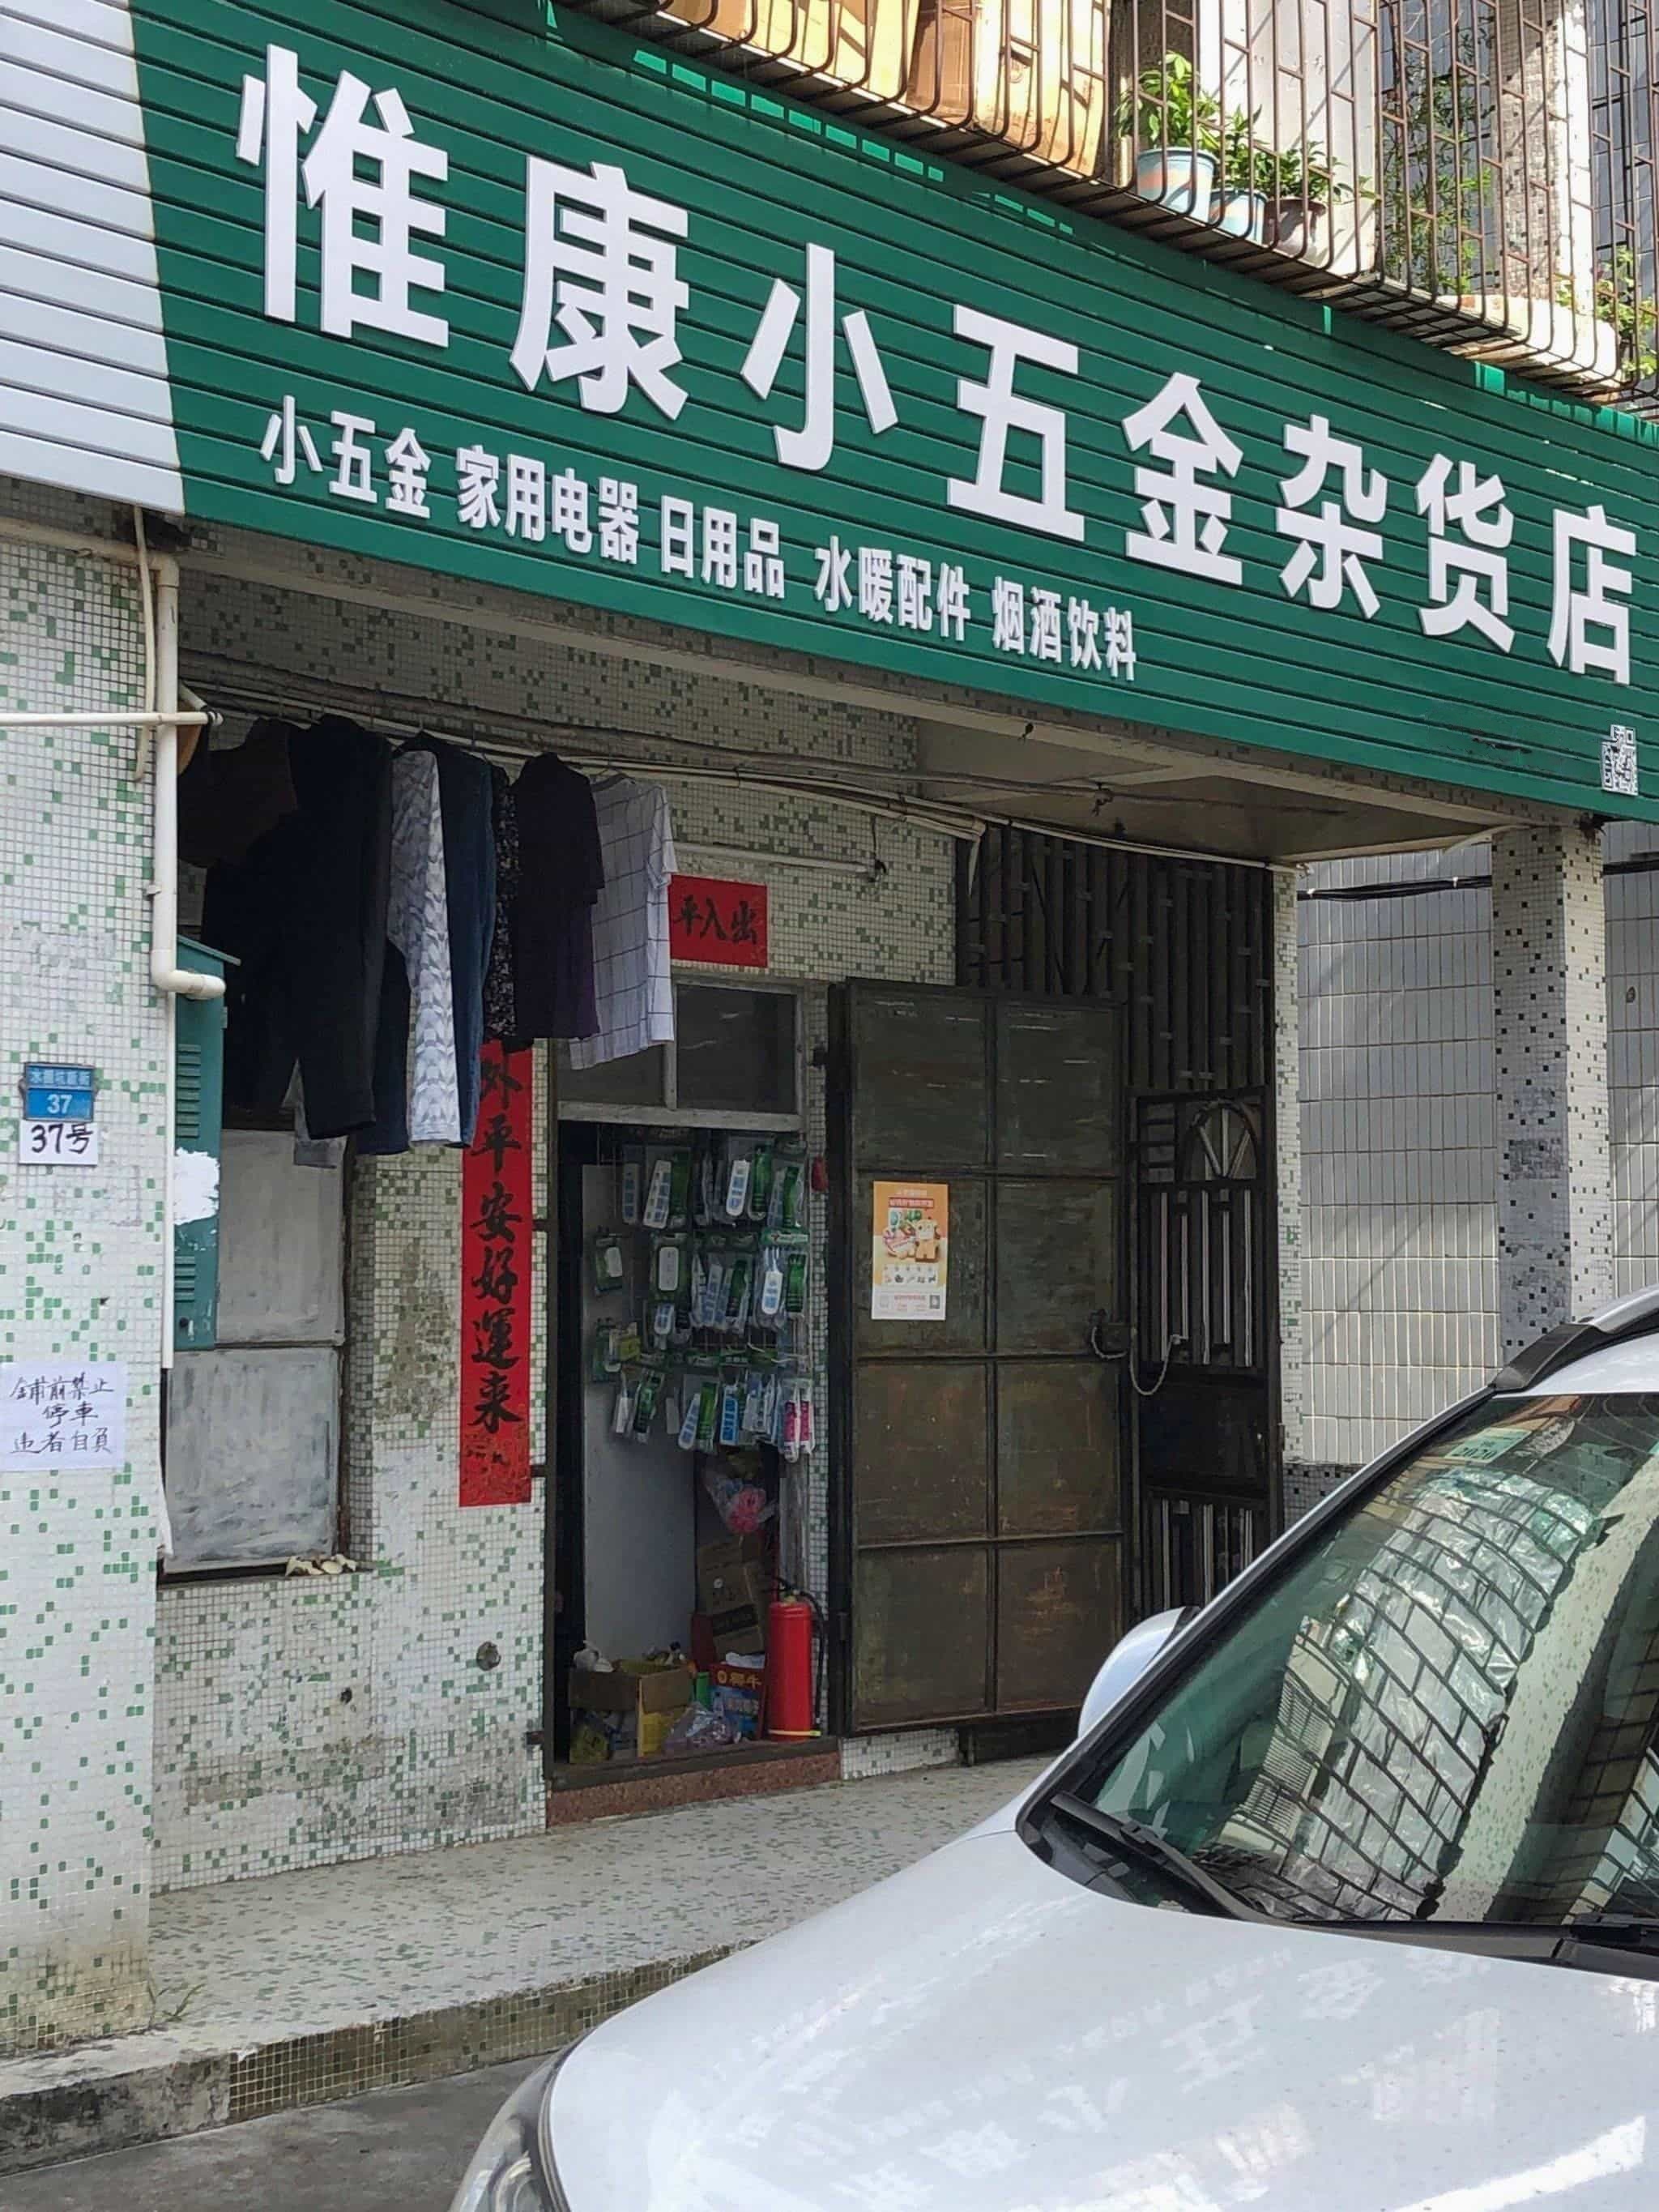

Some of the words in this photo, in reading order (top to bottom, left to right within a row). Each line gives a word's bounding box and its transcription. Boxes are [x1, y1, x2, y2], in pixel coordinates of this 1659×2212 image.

[236, 43, 1636, 685] 惟康小五金杂货店
[259, 395, 431, 519] 小五金
[456, 444, 640, 565] 家用电器
[660, 494, 785, 600] 日用品
[814, 535, 971, 642] 水暖配件
[991, 576, 1136, 681] 烟酒饮料
[31, 1123, 94, 1155] 37号
[47, 1094, 73, 1114] 37
